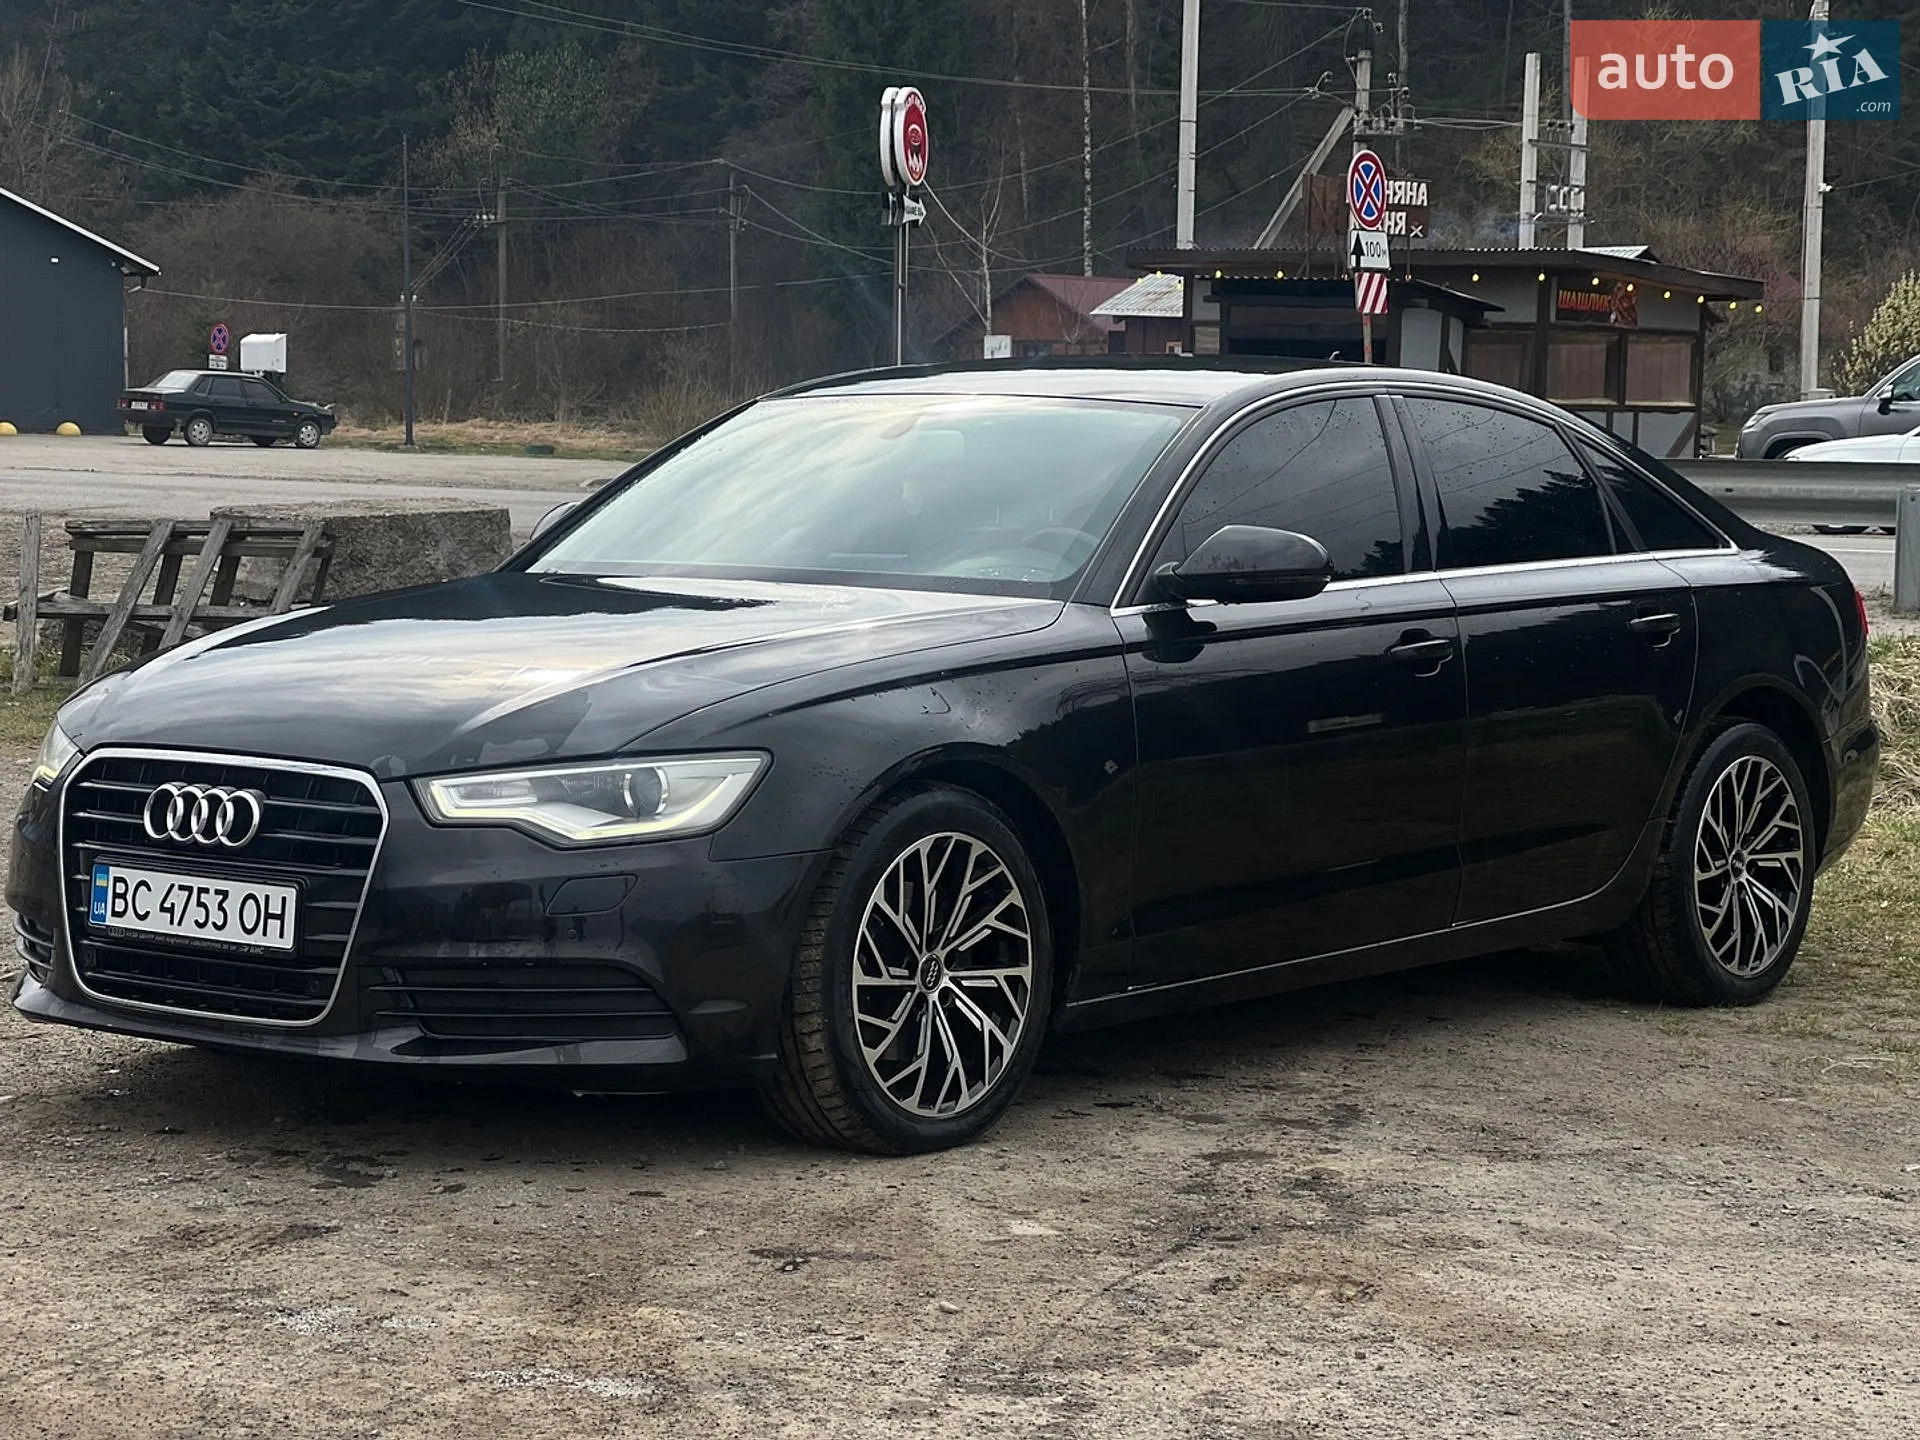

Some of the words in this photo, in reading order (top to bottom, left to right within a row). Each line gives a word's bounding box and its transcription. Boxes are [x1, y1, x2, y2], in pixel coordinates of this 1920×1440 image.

[93, 902, 106, 916] UA
[110, 875, 152, 922] BC
[158, 882, 230, 931] 4753
[238, 892, 288, 940] OH
